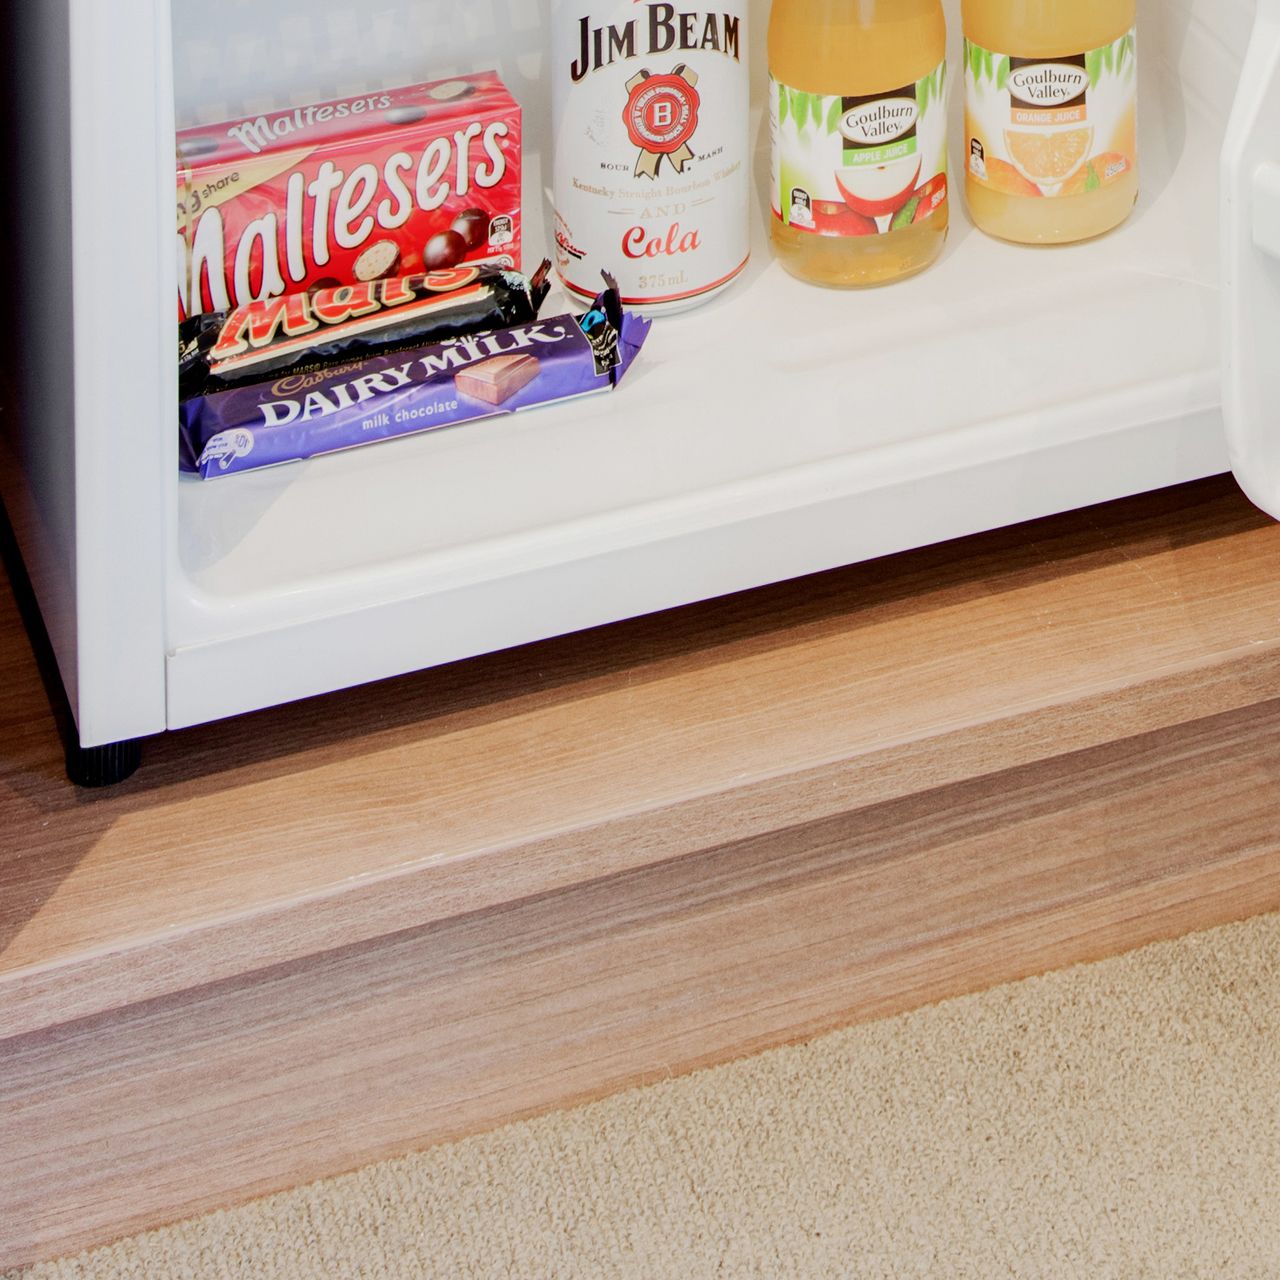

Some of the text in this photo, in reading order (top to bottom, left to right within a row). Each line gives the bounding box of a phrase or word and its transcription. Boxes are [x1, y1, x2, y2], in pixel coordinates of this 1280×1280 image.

[571, 3, 741, 83] JIM BEAM
[1013, 69, 1082, 88] Goulburn
[227, 92, 392, 154] Maltesers
[653, 102, 673, 127] B
[846, 104, 913, 128] Goulburn
[1016, 109, 1080, 122] ORANGE JUICE
[853, 144, 908, 163] APPLE JUICE
[200, 171, 240, 200] share
[572, 176, 615, 200] Kentucky
[177, 121, 508, 311] Maltesers
[640, 203, 687, 219] AND
[621, 223, 701, 259] Cola
[256, 364, 412, 429] DAIRY
[423, 323, 567, 378] MILK
[362, 398, 459, 431] milk chocolate
